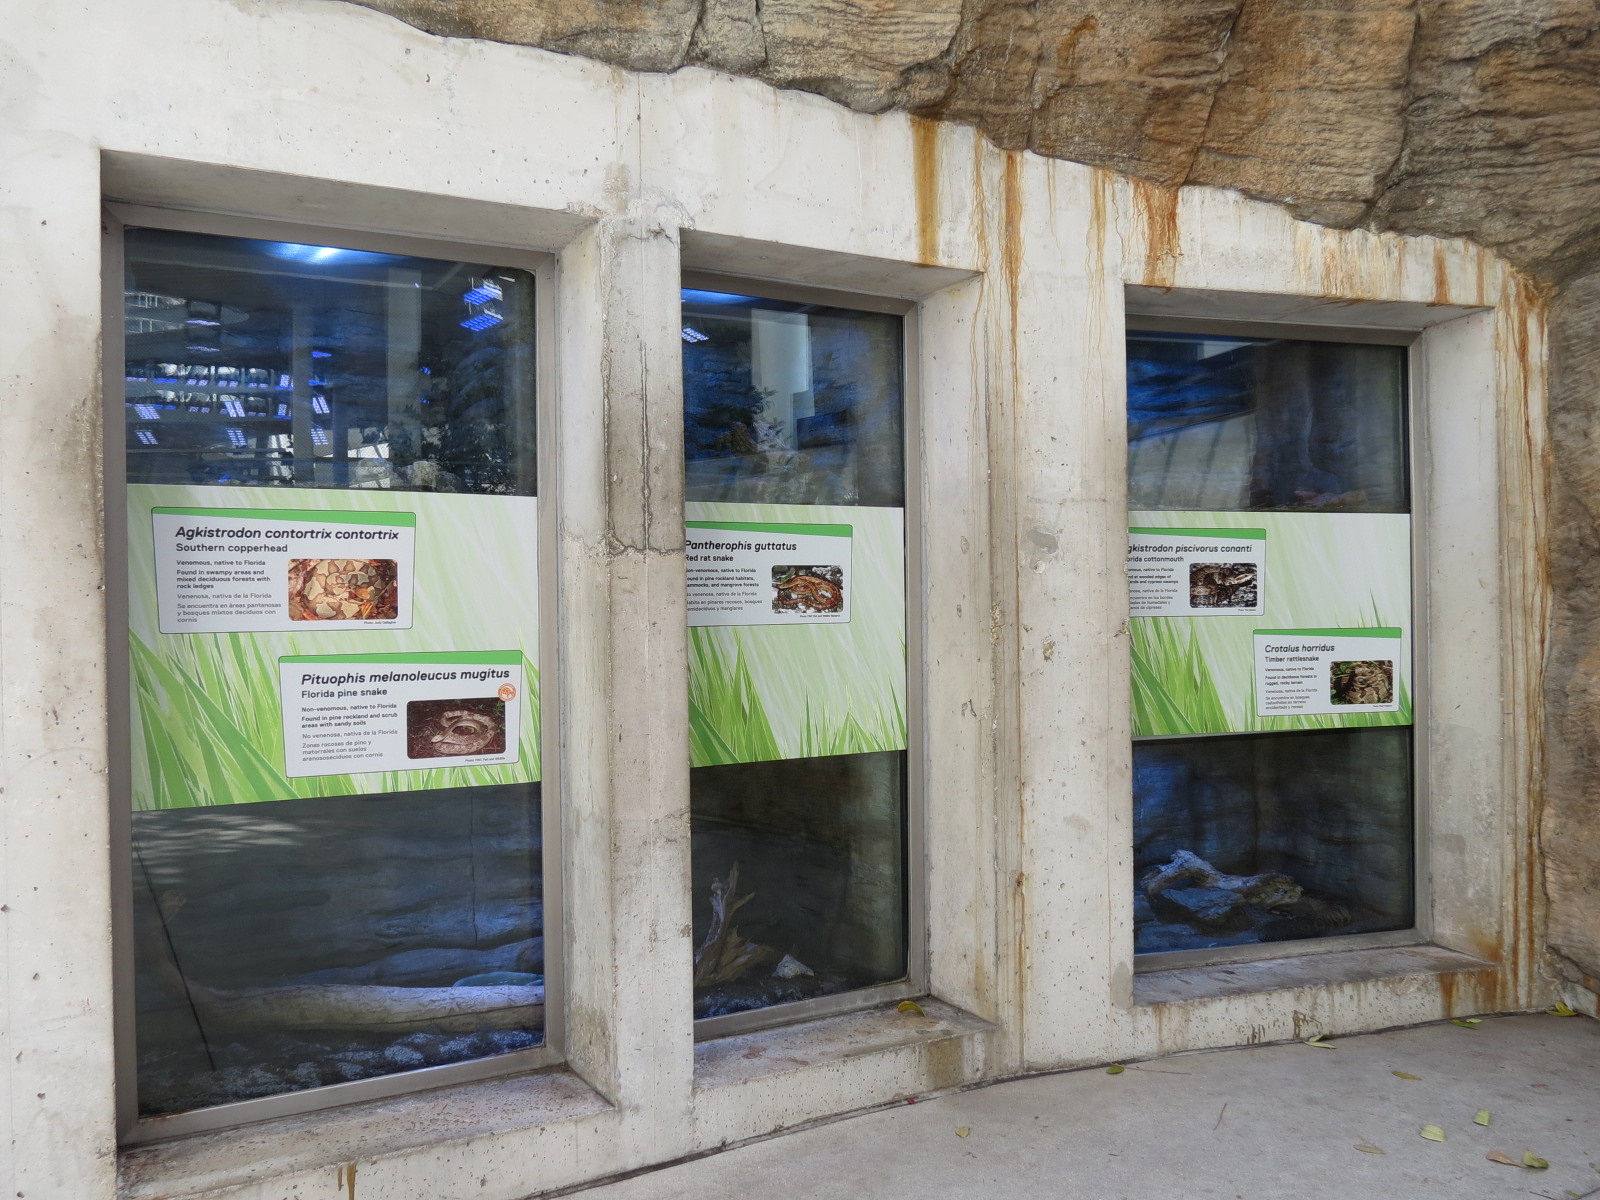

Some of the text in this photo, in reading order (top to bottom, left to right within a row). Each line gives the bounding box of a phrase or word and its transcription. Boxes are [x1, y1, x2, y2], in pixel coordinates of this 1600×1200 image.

[175, 526, 399, 540] Agkistrodon contortrix contortrix
[176, 543, 288, 554] Southern copperhead
[754, 542, 797, 553] guttatus
[1127, 544, 1252, 554] gkistrodon piscivorus conanti
[1265, 644, 1335, 653] Crotalus horridus
[301, 668, 509, 686] Pituophis melanoleucus mugitus
[301, 688, 388, 699] Florida pine snake
